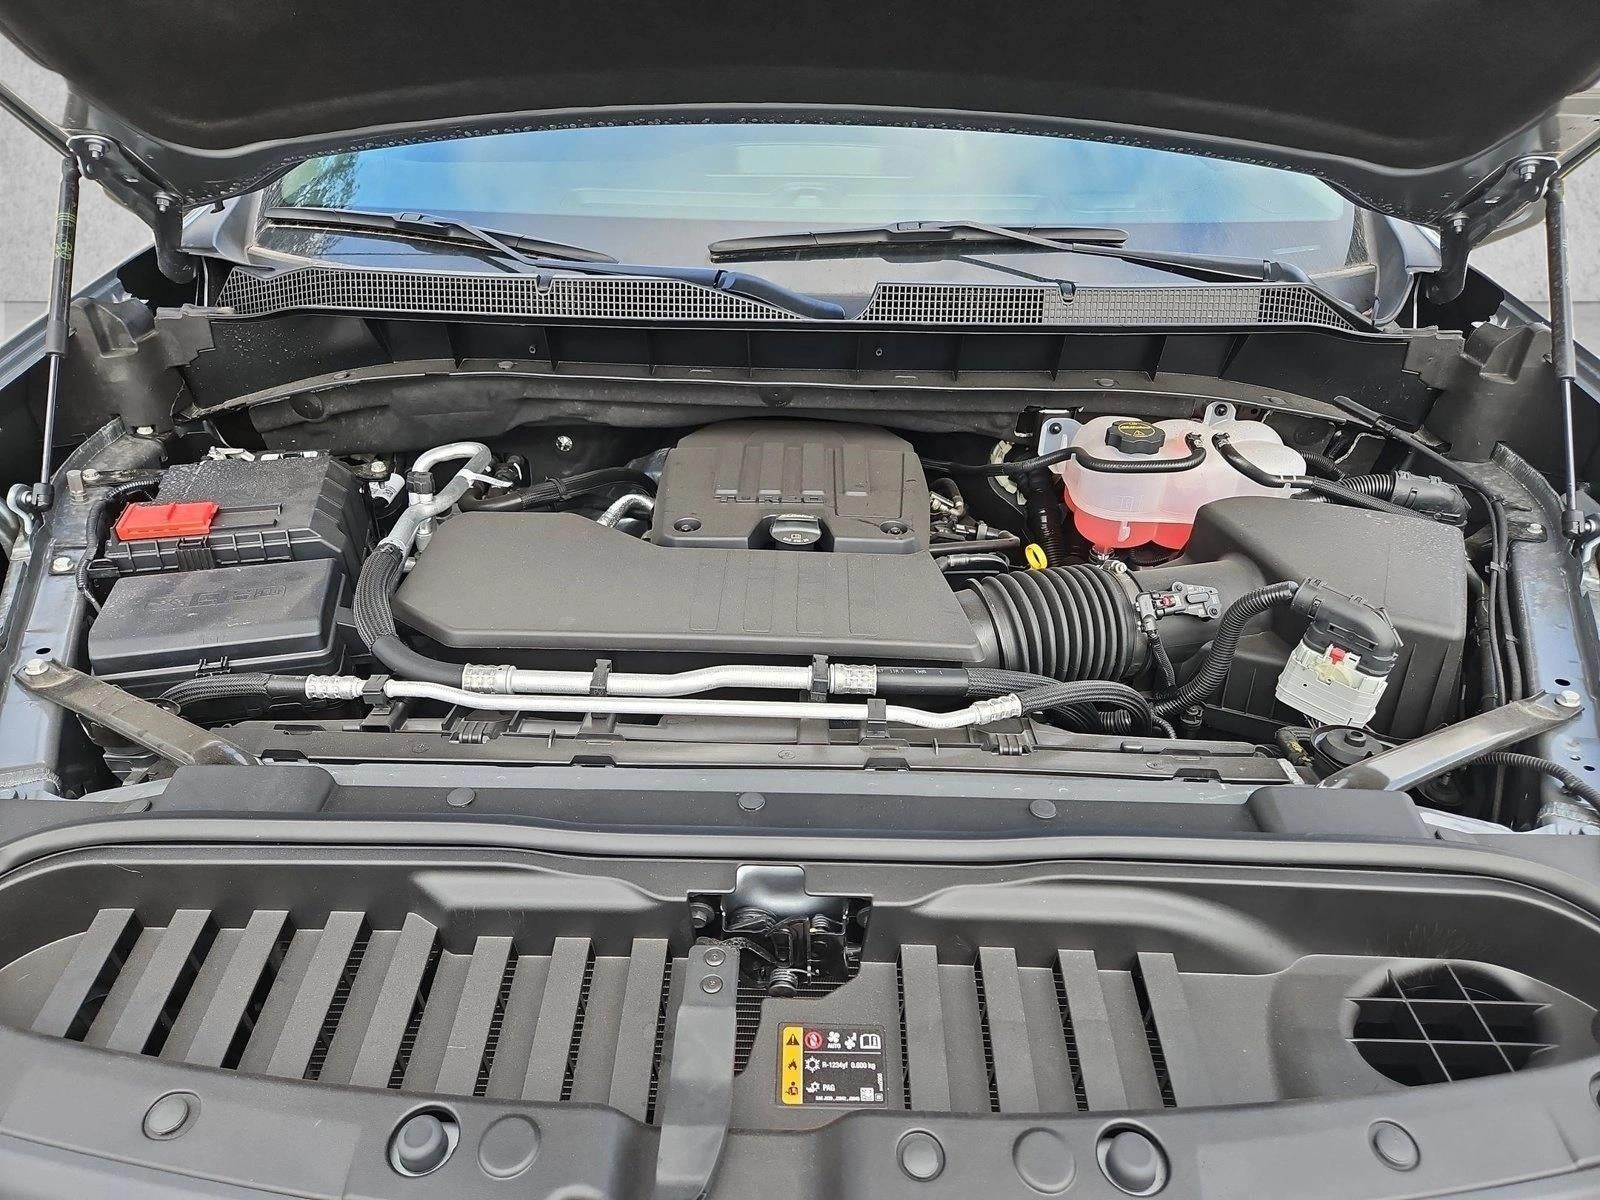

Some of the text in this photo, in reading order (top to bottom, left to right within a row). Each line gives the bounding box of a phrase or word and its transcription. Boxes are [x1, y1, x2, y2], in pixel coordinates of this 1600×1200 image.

[822, 1061, 848, 1070] R-1234yf
[868, 1061, 876, 1071] kg
[822, 1083, 836, 1092] PAG
